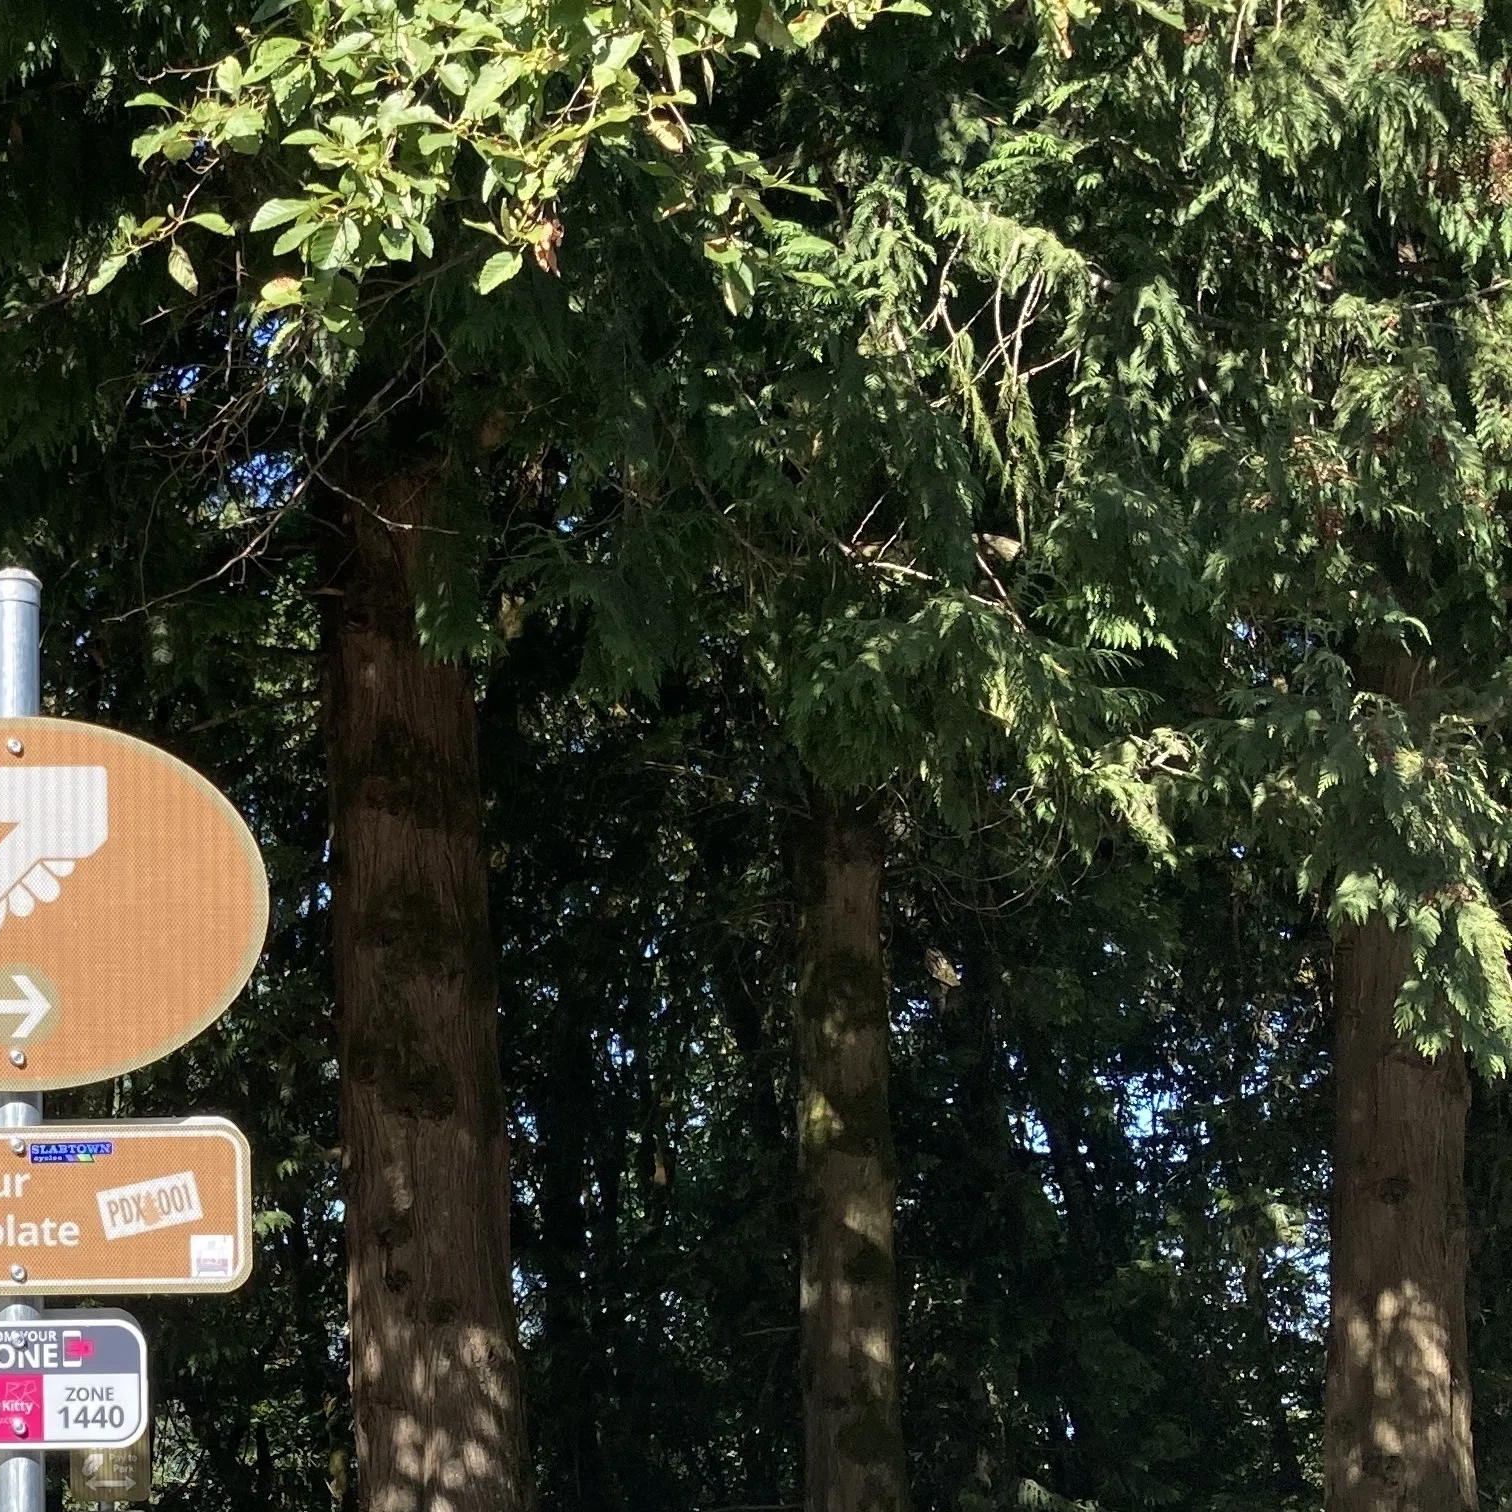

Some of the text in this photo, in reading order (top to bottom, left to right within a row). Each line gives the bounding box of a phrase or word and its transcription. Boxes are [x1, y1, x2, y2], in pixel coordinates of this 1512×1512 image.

[31, 1143, 112, 1155] SLABTOWN
[33, 1154, 63, 1163] cycles
[107, 1182, 194, 1230] PDX 001
[19, 1330, 58, 1342] YOUR
[65, 1386, 115, 1402] ZONE
[1, 1399, 35, 1416] Kitty
[57, 1404, 126, 1430] 1440
[109, 1453, 138, 1466] Pay to
[113, 1463, 136, 1474] Park
